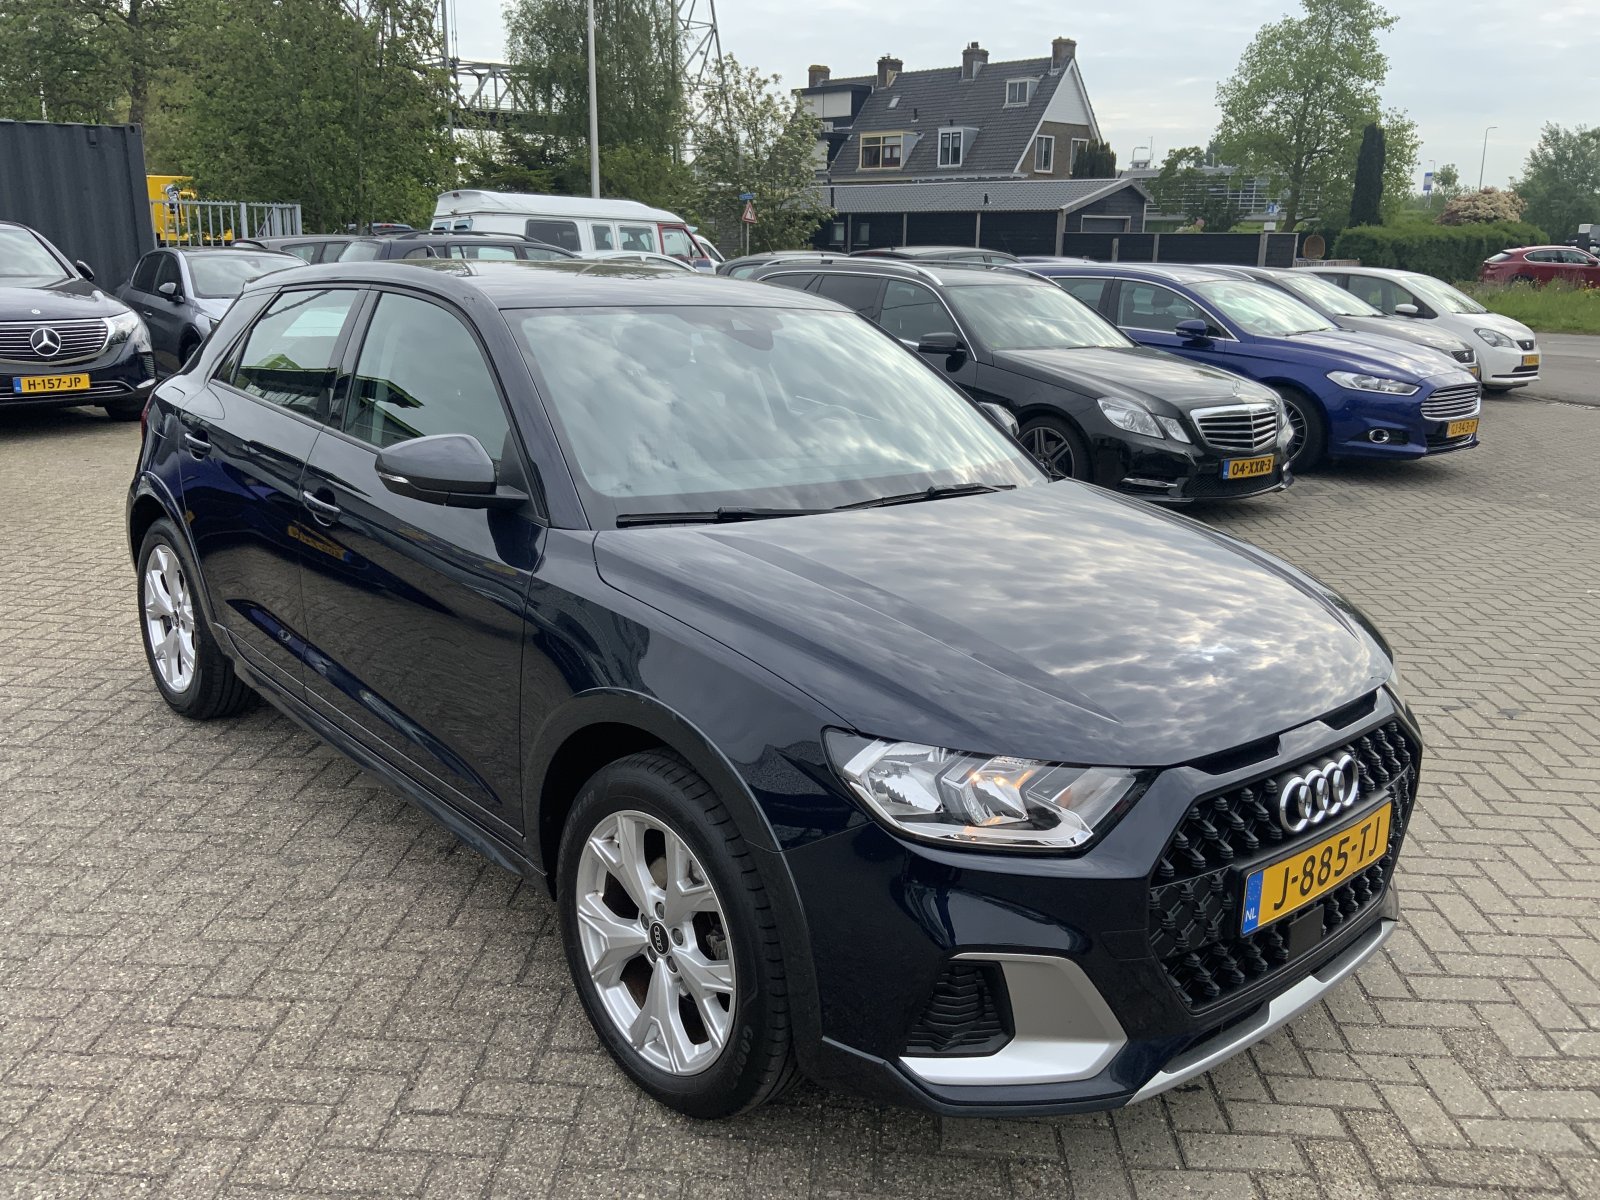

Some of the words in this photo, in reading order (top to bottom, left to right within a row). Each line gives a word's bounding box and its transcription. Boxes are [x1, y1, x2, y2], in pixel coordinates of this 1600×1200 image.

[28, 377, 81, 390] H-157-JP
[1232, 459, 1272, 476] 04-XXR-3
[1274, 817, 1380, 910] J-885-TJ
[1245, 907, 1257, 922] NL
